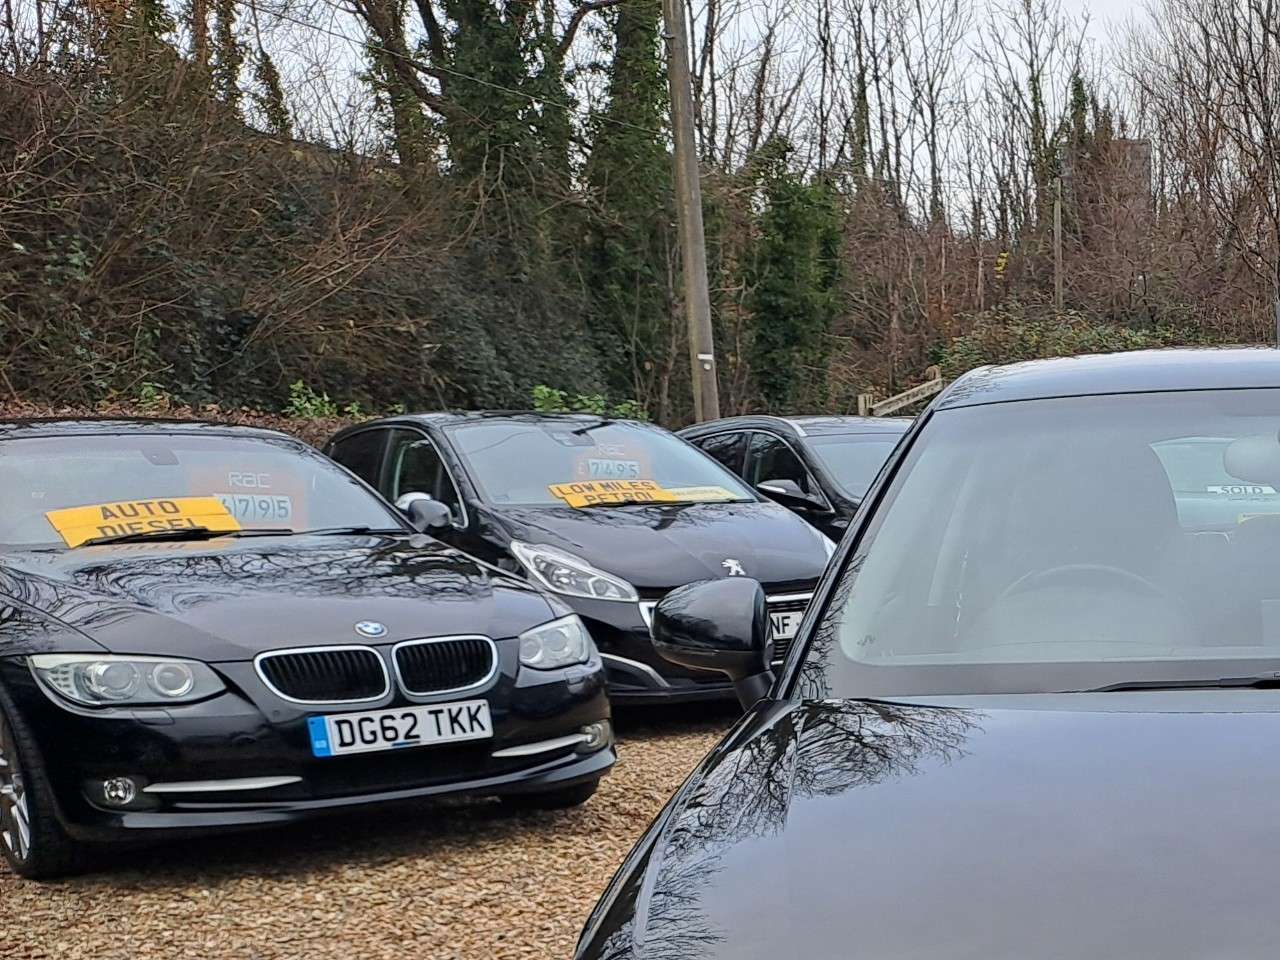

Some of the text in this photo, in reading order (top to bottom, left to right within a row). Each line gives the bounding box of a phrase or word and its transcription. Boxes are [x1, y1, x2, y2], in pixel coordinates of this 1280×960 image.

[556, 481, 657, 496] LOW MILES
[100, 501, 181, 520] AUTO
[335, 704, 486, 748] DG62 TKK
